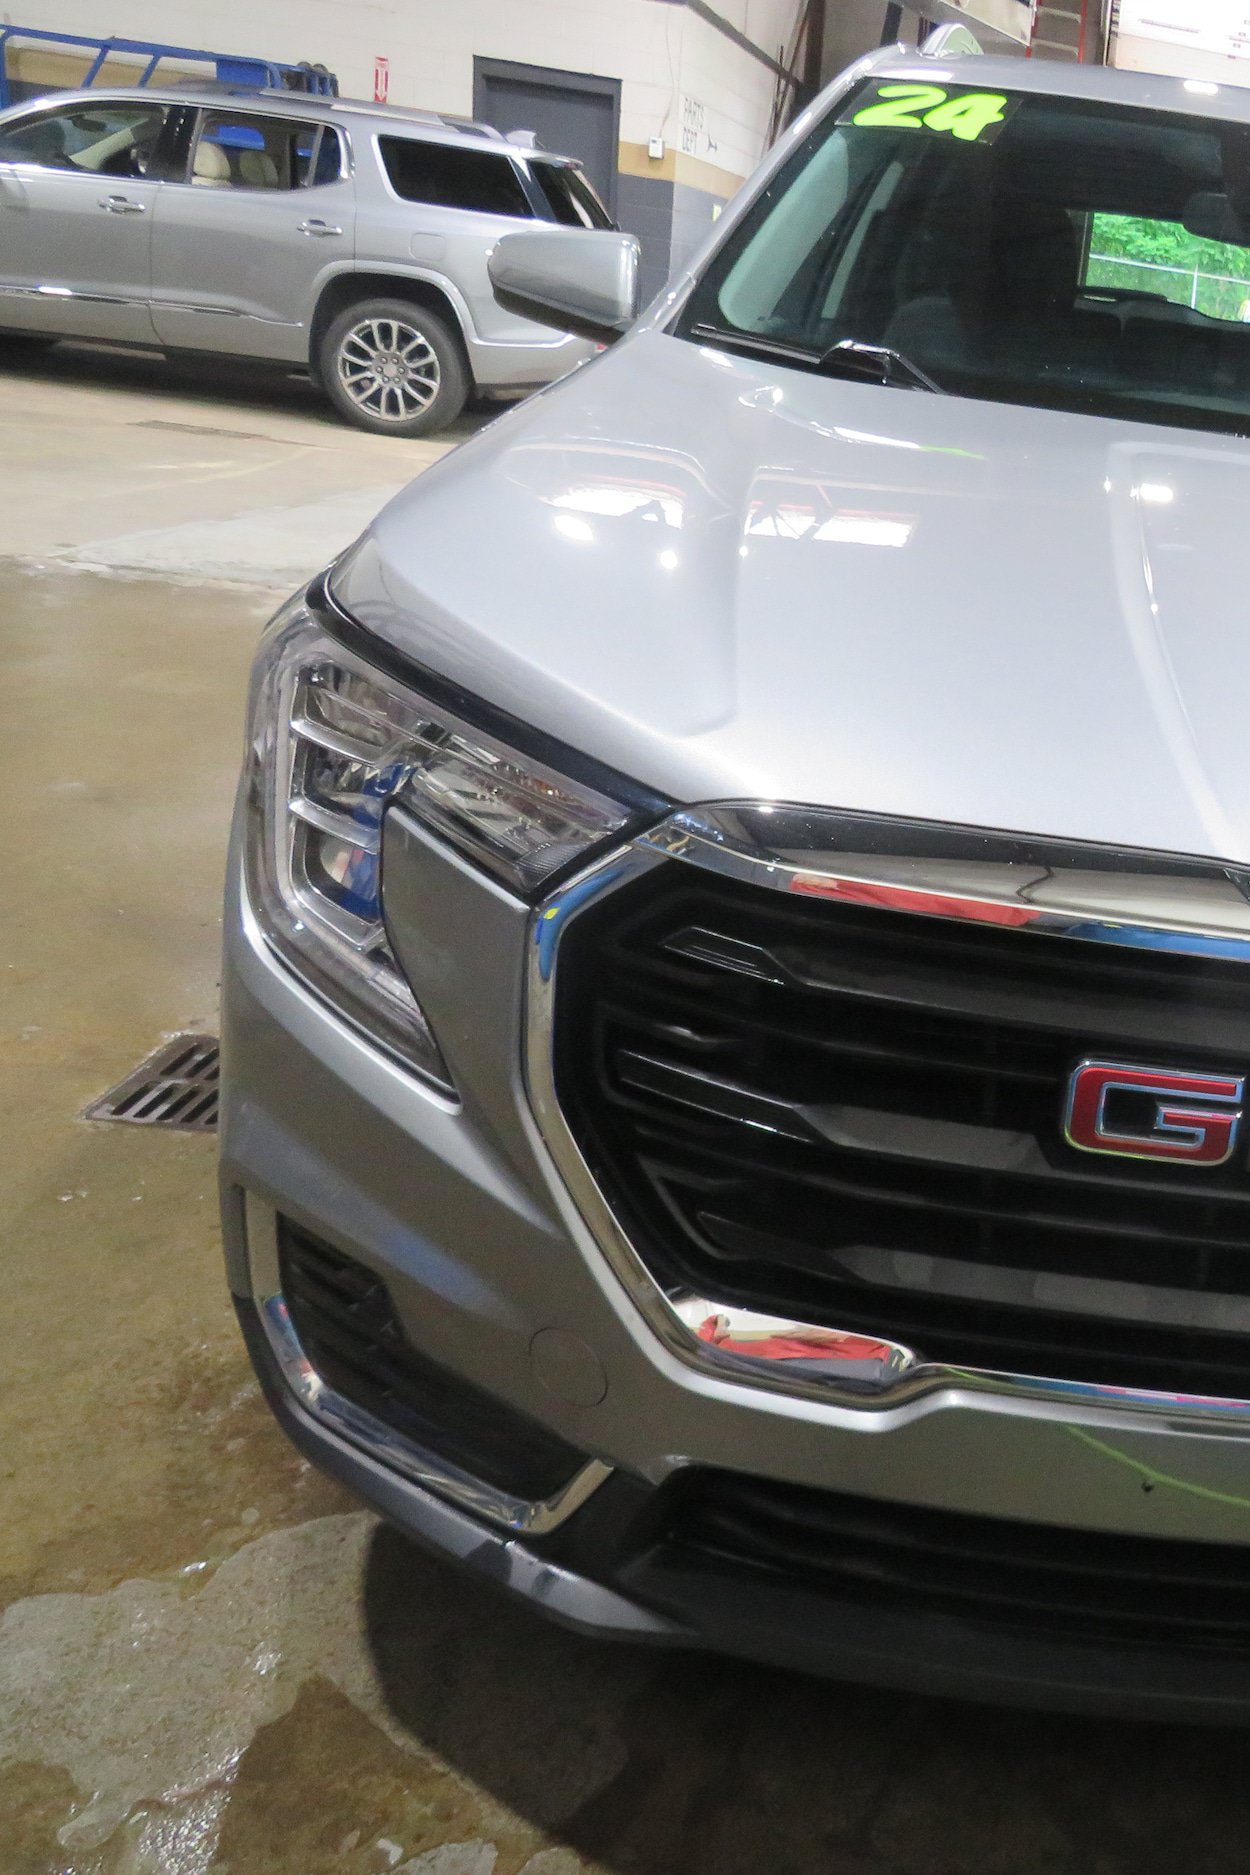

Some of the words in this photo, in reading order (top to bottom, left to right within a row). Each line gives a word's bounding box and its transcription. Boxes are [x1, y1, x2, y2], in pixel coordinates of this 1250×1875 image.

[683, 97, 704, 129] PARTS
[853, 84, 1008, 141] 24
[682, 126, 698, 154] DEPT
